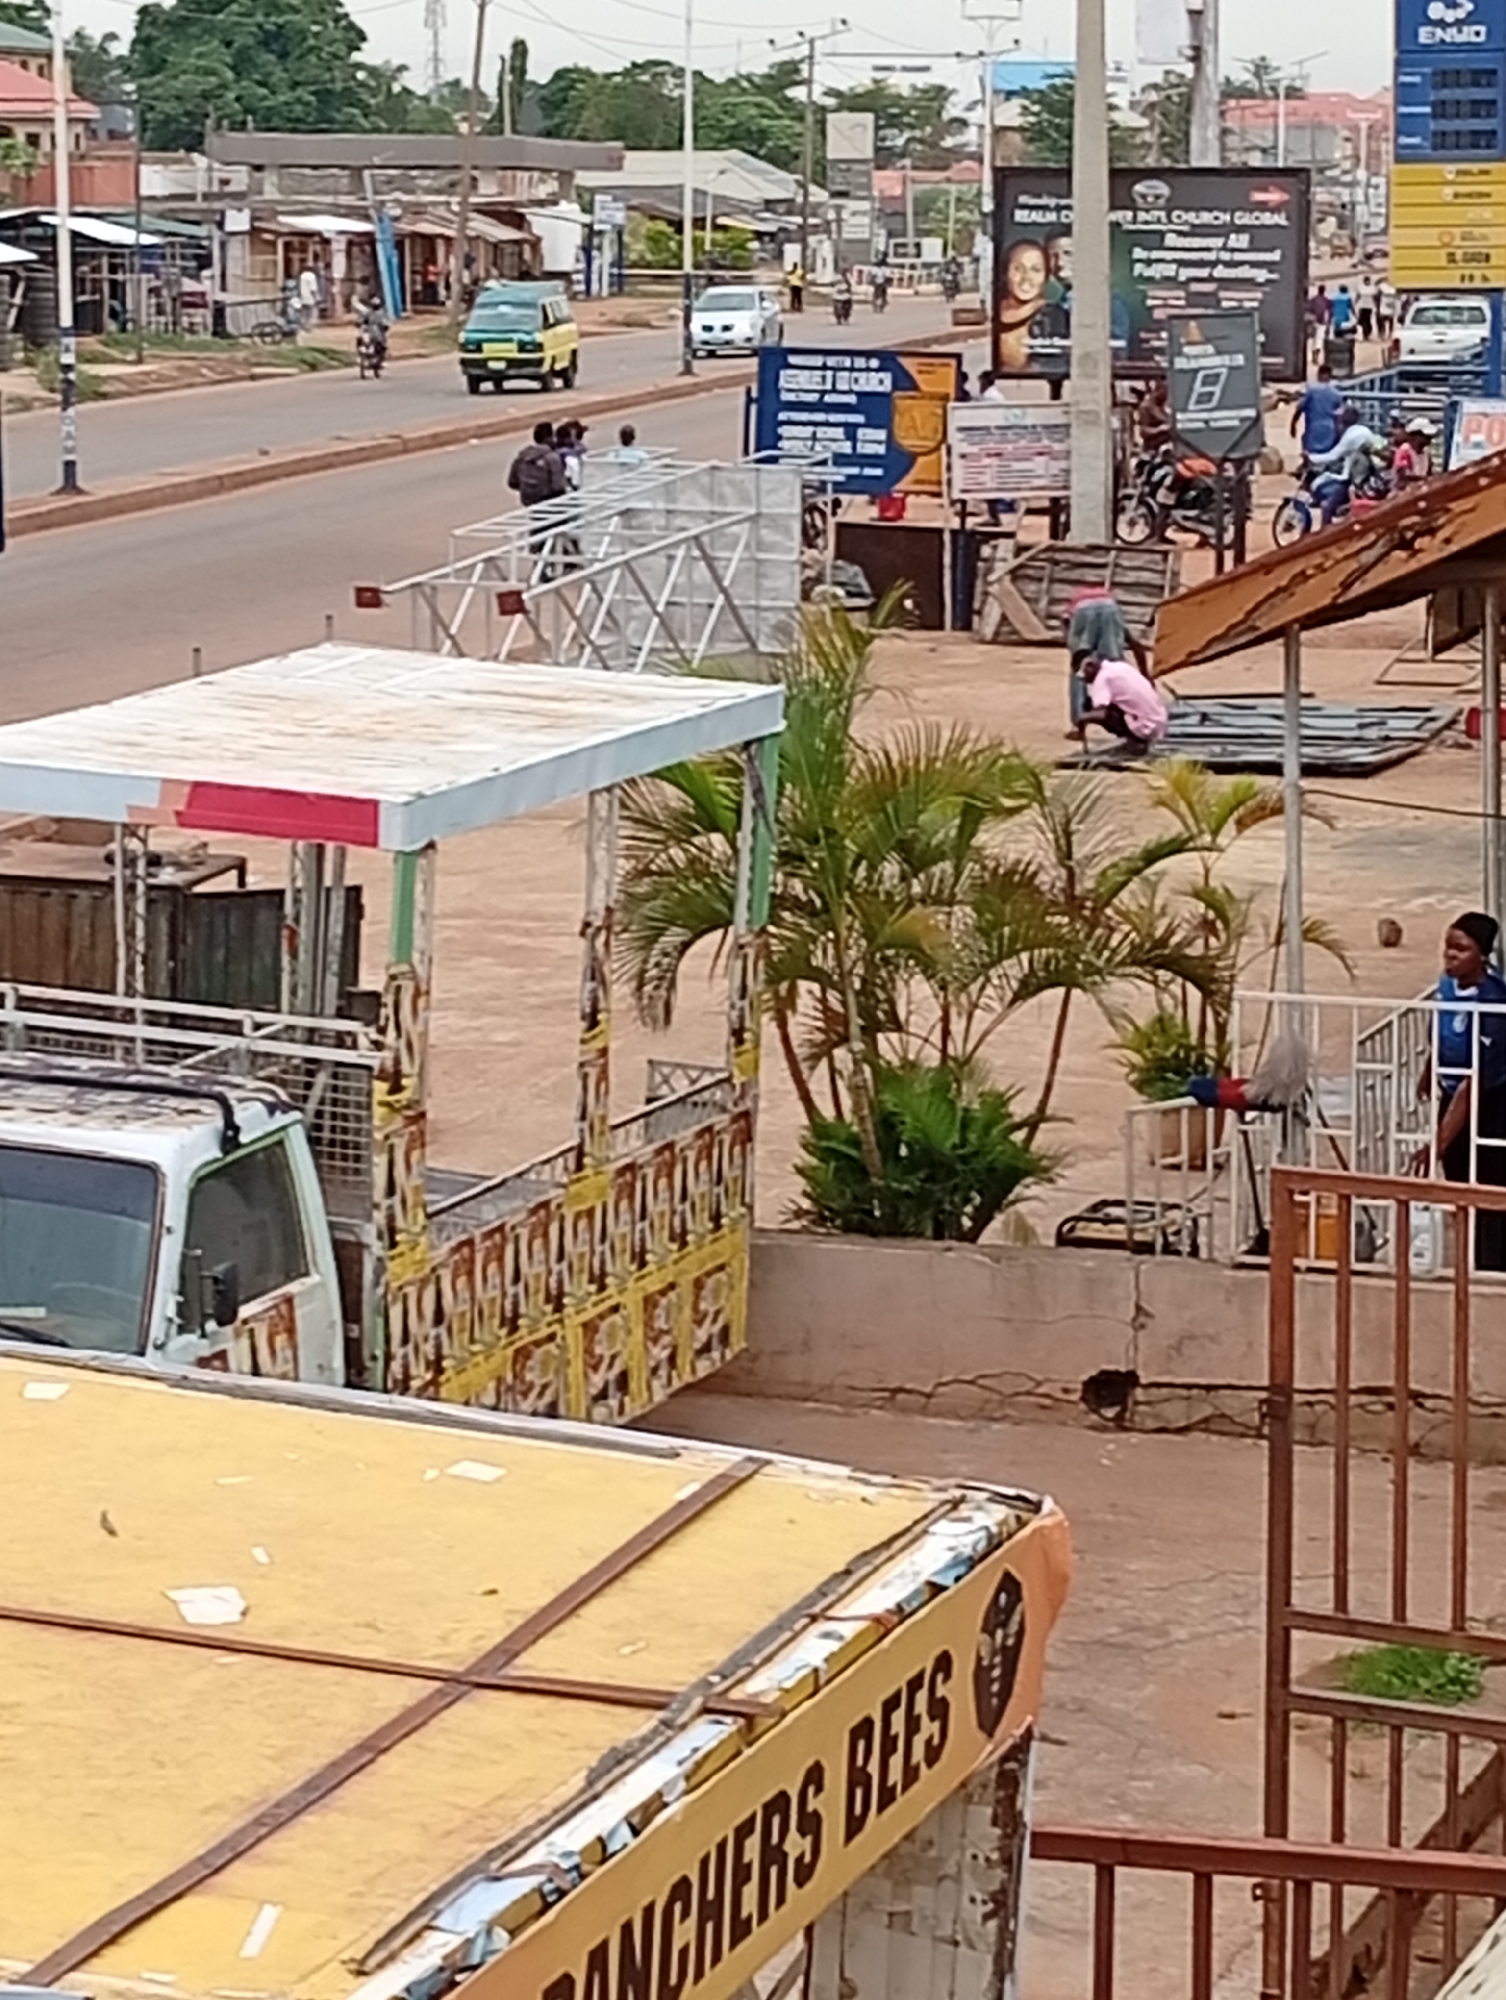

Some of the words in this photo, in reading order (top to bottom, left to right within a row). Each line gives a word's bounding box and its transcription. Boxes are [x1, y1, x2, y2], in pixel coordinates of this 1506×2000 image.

[1170, 209, 1231, 225] CHURCH
[1233, 210, 1290, 226] GLOBAL
[541, 1759, 826, 2000] ANCHERS
[843, 1649, 953, 1849] BEES
